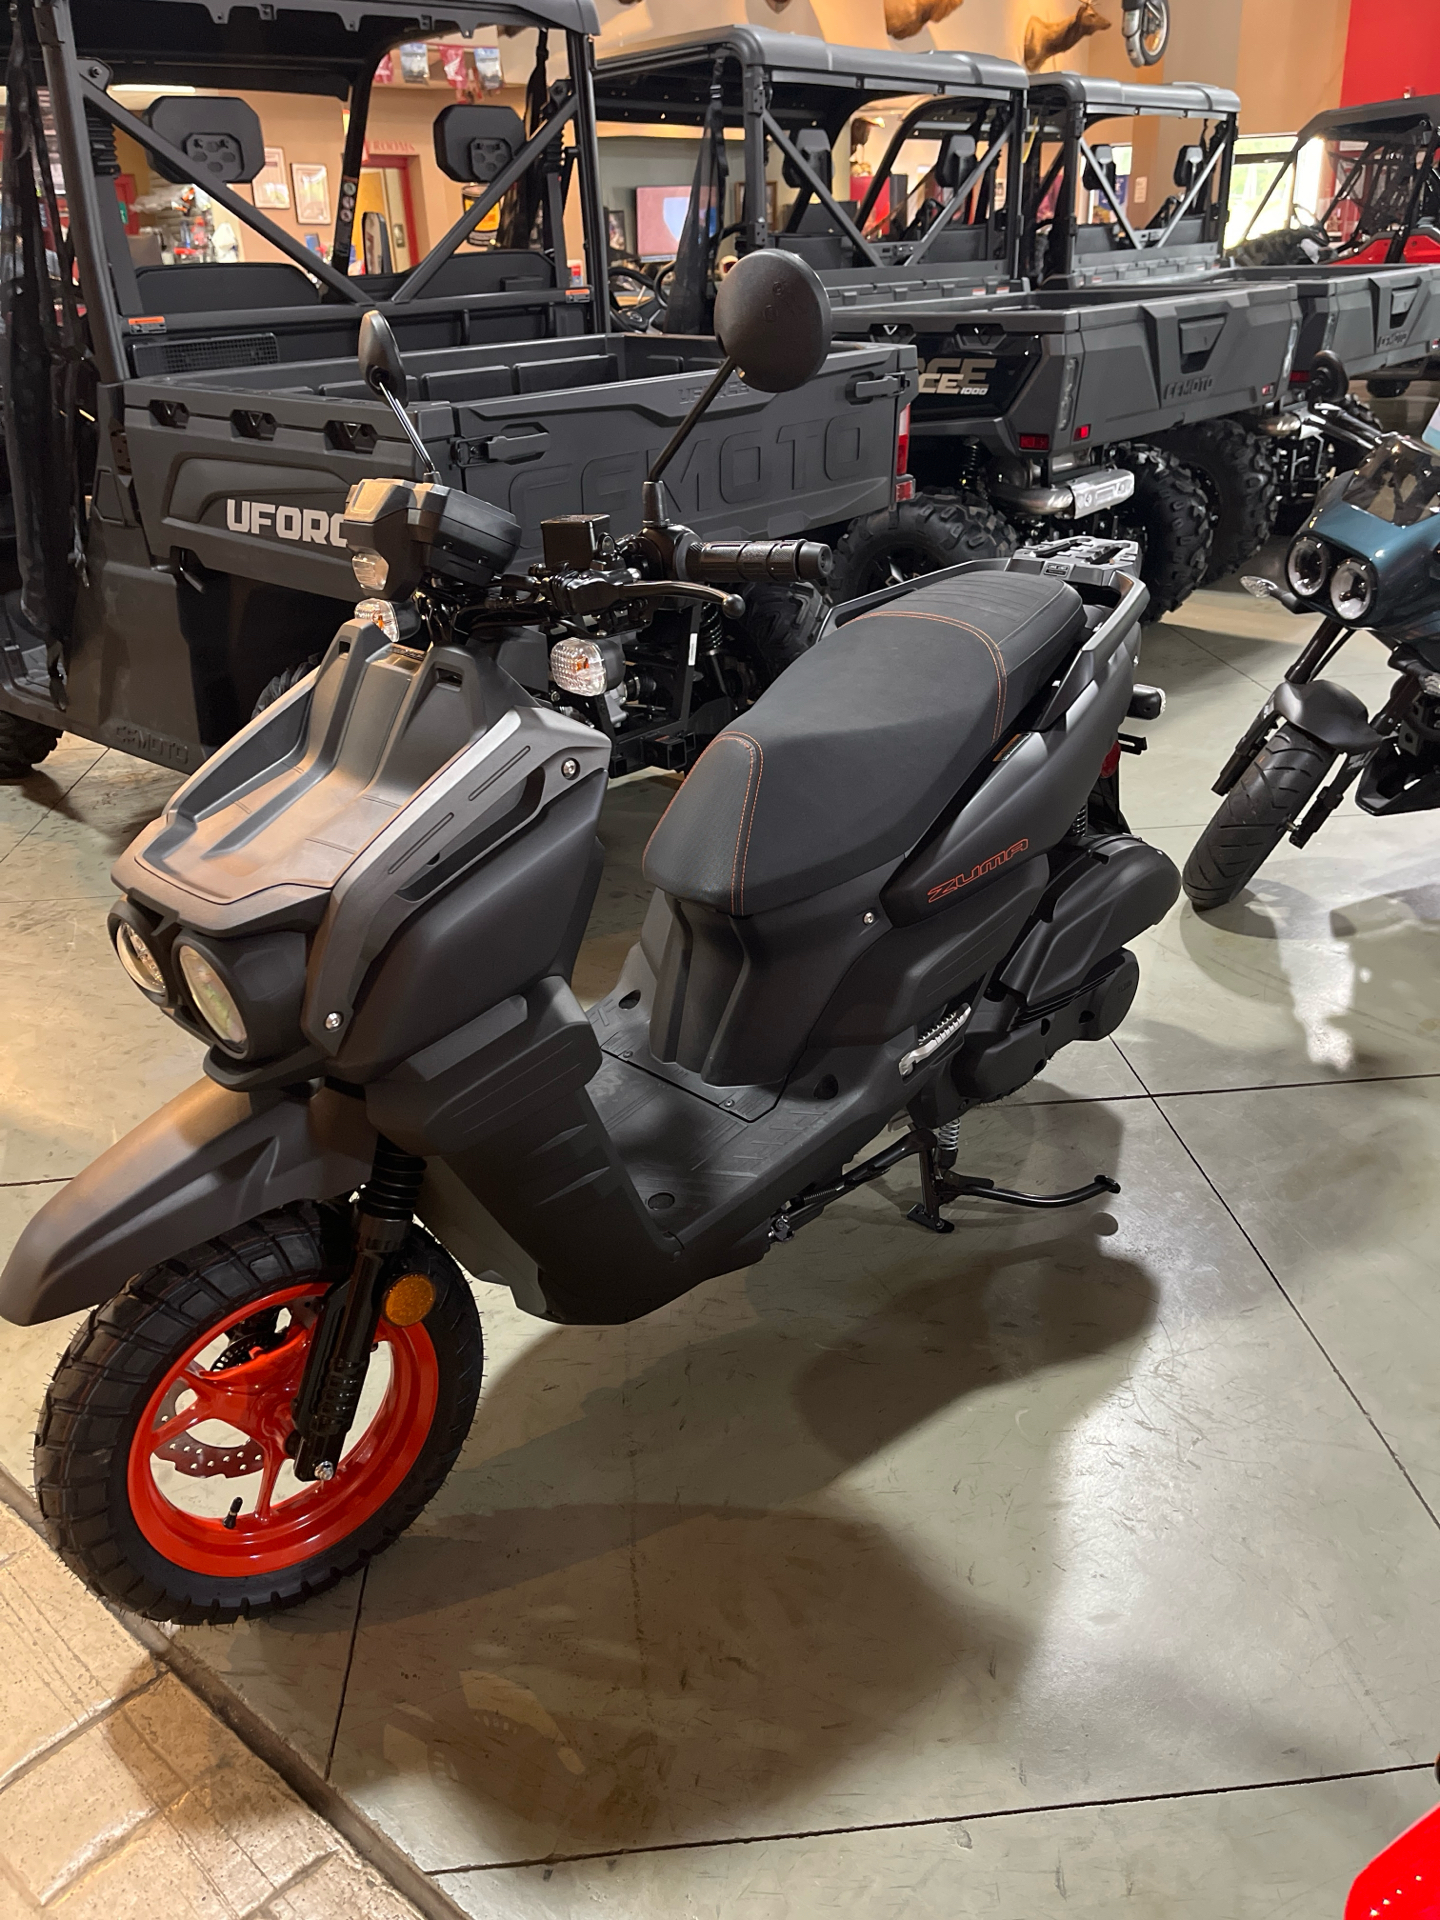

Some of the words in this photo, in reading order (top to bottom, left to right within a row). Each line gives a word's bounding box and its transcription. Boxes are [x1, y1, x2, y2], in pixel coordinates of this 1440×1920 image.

[960, 387, 989, 396] 1000
[226, 498, 348, 548] UFORC
[927, 838, 1029, 904] ZUMA
